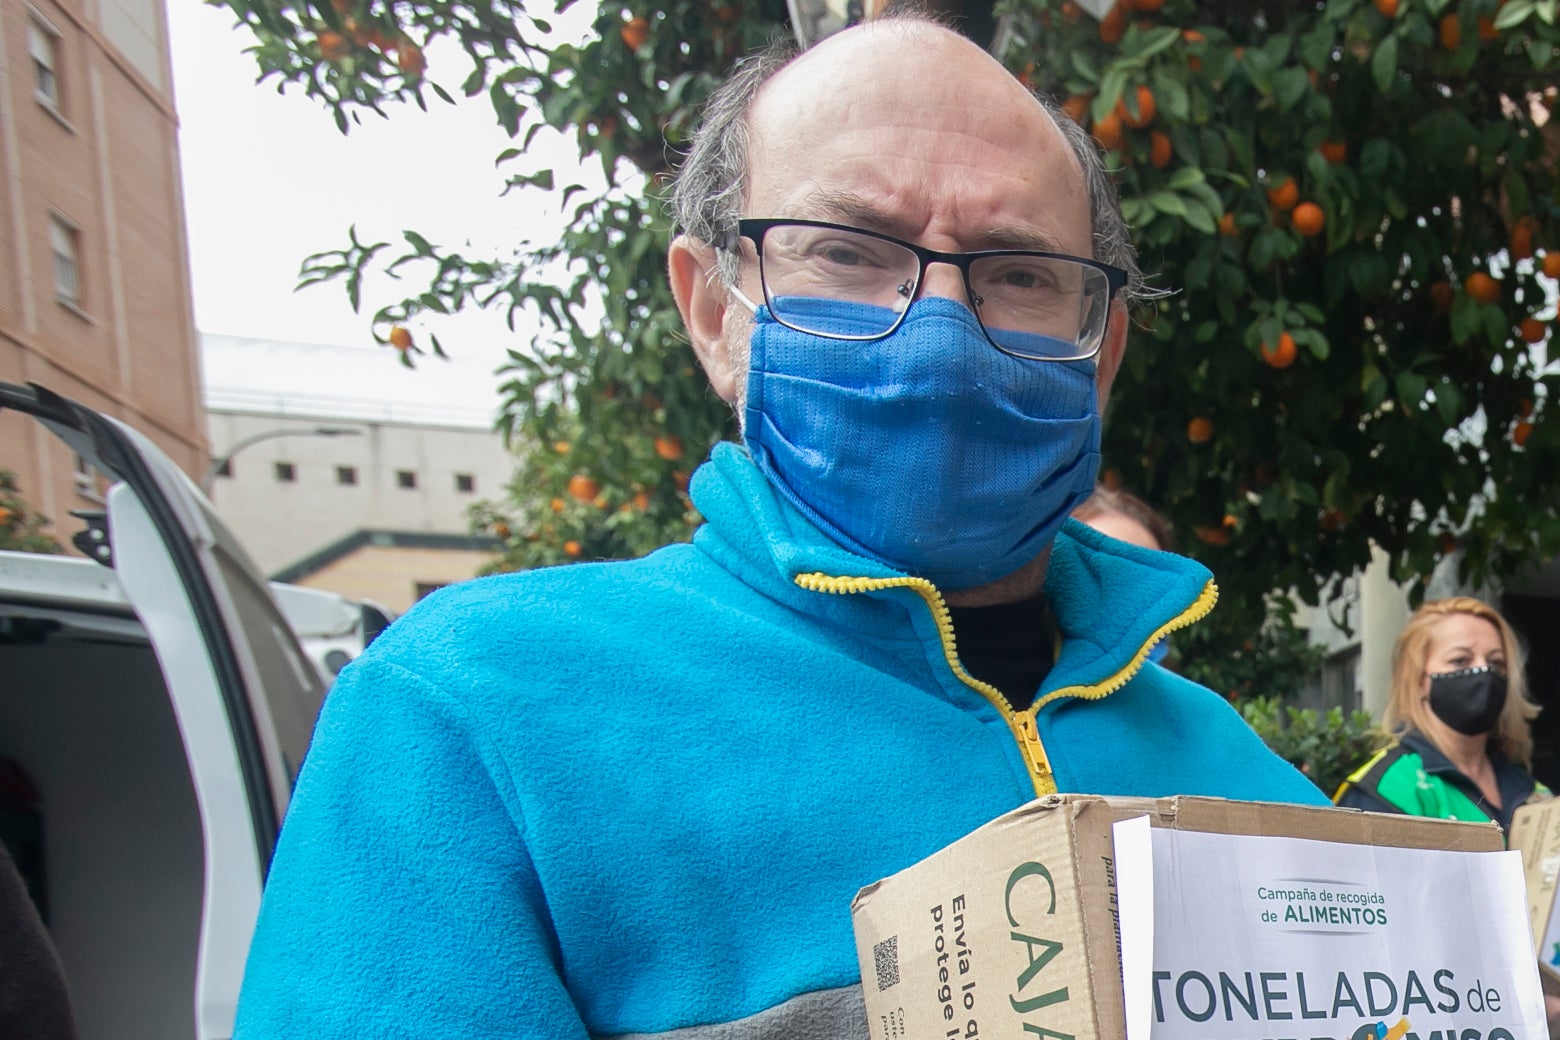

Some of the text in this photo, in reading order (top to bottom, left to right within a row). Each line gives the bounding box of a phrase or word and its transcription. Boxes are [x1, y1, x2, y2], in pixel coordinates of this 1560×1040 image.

[1258, 887, 1385, 906] Campaña de recogida
[1261, 905, 1387, 925] de ALIMENTOS
[952, 893, 973, 976] Envía
[930, 904, 954, 1021] protege
[961, 981, 976, 1011] lo
[1152, 969, 1501, 1023] TONELADAS de
[897, 1006, 905, 1035] Con
